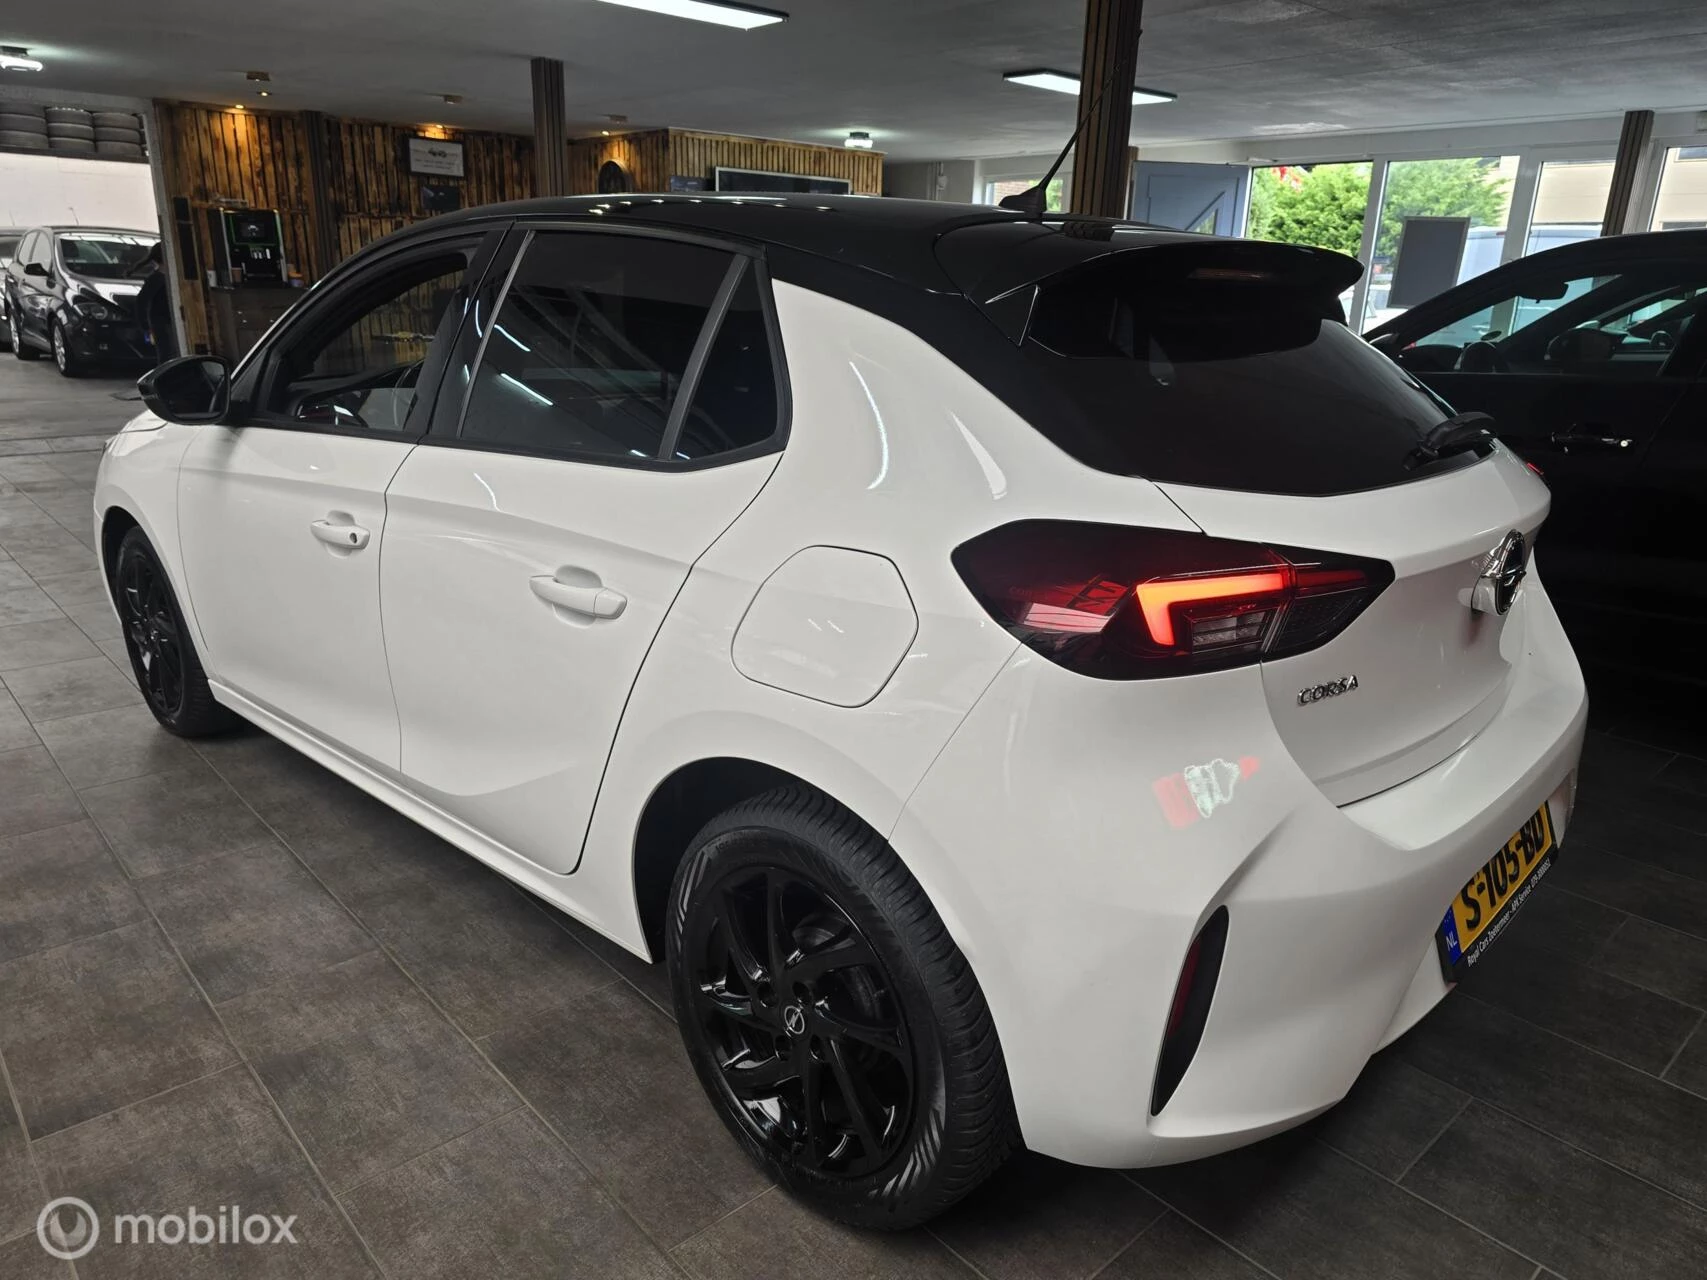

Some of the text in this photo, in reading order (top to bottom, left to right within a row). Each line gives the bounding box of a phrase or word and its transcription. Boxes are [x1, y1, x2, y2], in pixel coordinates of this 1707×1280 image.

[1297, 674, 1359, 706] CORSA
[1446, 932, 1458, 950] NL
[1467, 945, 1480, 967] Royal
[1480, 936, 1489, 952] Cars
